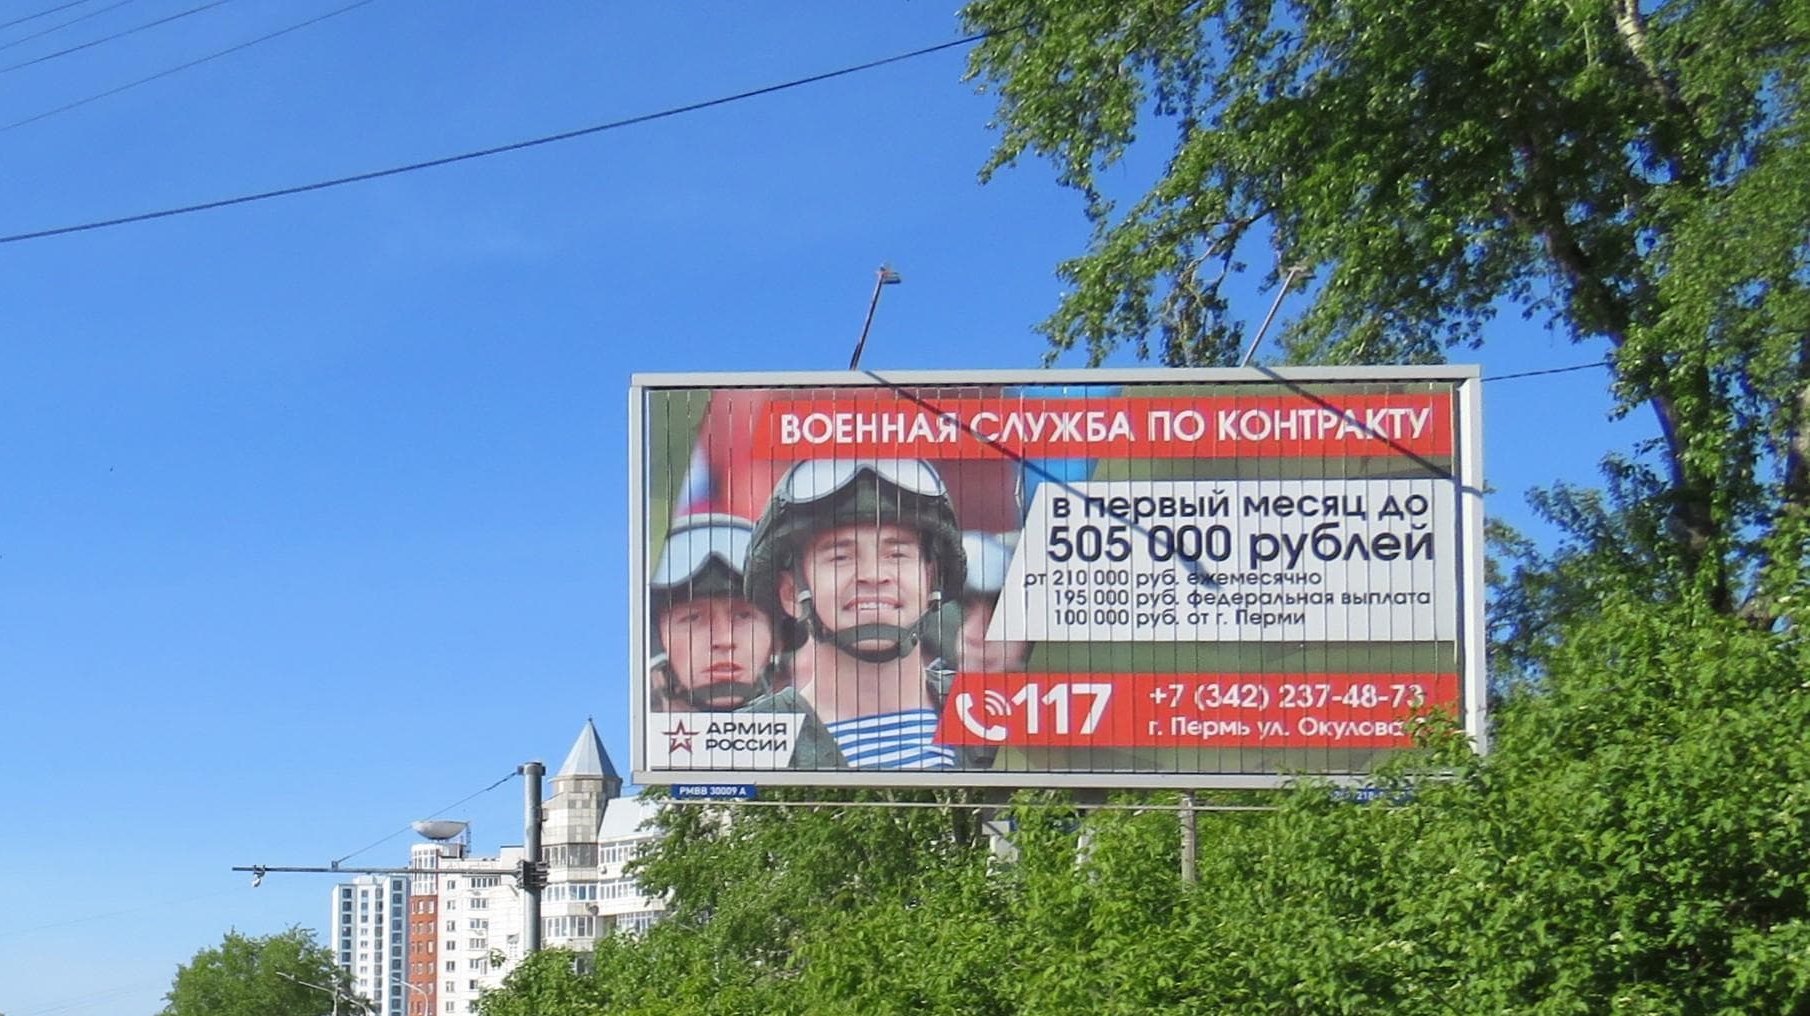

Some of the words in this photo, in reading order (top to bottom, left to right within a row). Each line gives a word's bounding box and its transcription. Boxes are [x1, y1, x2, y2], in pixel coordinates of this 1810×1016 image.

[781, 411, 957, 444] ВОЕННАЯ
[970, 410, 1135, 443] СЛУЖБА
[1148, 409, 1205, 442] ПО
[1218, 407, 1430, 441] КОНТРАКТУ
[1053, 497, 1071, 518] в
[1085, 488, 1229, 525] первый
[1243, 494, 1367, 522] месяц
[1377, 493, 1429, 522] до
[1048, 524, 1132, 562] 505
[1148, 524, 1232, 562] 000
[1250, 521, 1435, 570] рублей
[1052, 569, 1087, 586] 210
[1093, 569, 1129, 586] 000
[1136, 568, 1179, 589] руб.
[1187, 571, 1322, 586] ежемесячно
[1055, 589, 1087, 606] 195
[1093, 589, 1129, 606] 000
[1136, 588, 1179, 609] руб.
[1187, 590, 1334, 608] федеральная
[1341, 591, 1431, 605] выплата
[1055, 609, 1087, 626] 100
[1093, 609, 1129, 626] 000
[1136, 608, 1179, 629] руб.
[1187, 612, 1209, 626] от
[1216, 612, 1228, 626] г.
[1235, 609, 1306, 628] Перми
[1012, 682, 1112, 736] 117
[1149, 683, 1184, 708] +7
[1194, 683, 1270, 712] (342)
[1278, 683, 1425, 709] 237-48-73
[706, 721, 788, 736] АРМИЯ
[1148, 721, 1163, 736] г.
[1171, 716, 1251, 740] Пермь
[1256, 721, 1290, 740] ул.
[705, 738, 788, 752] РОССИИ
